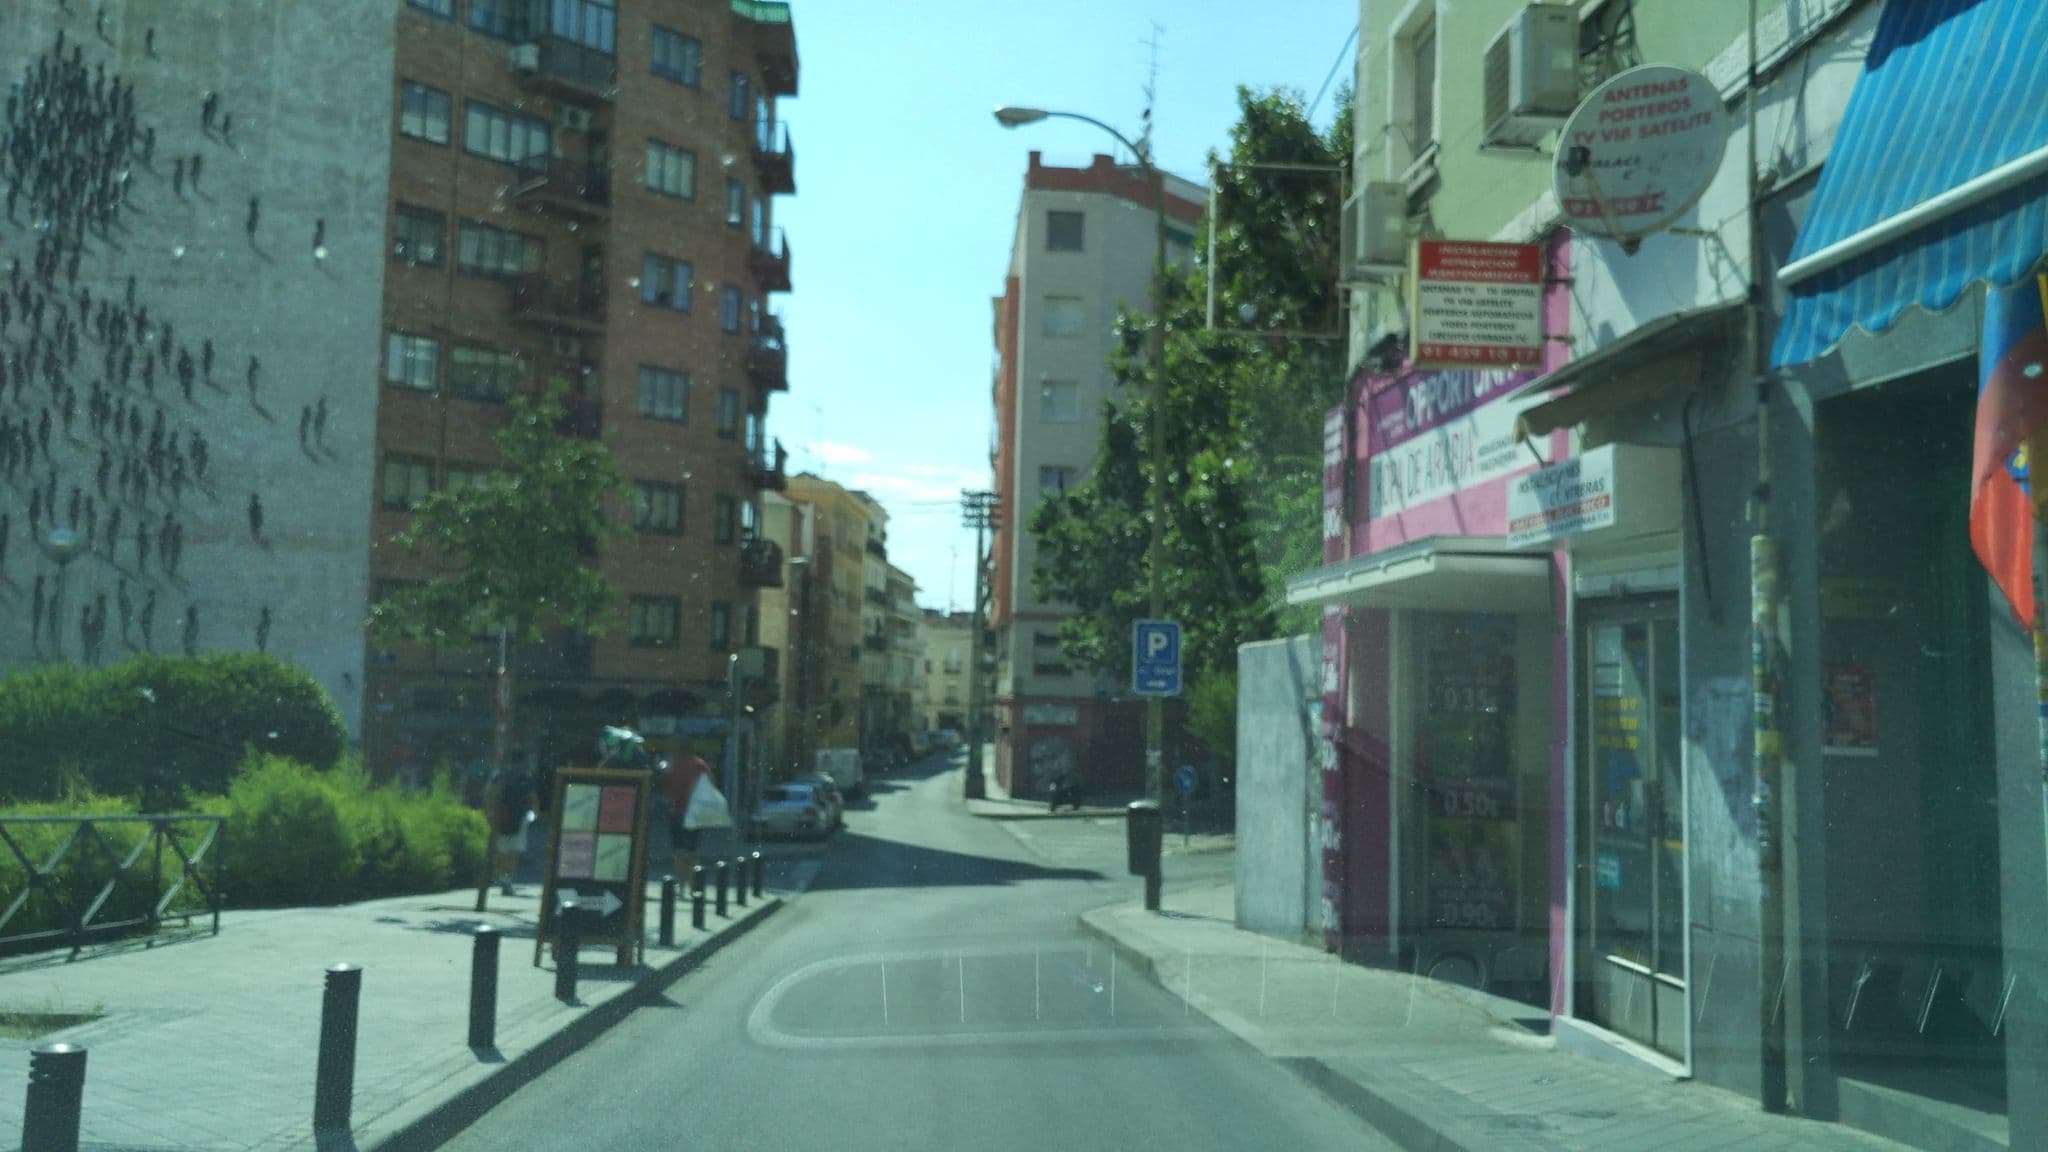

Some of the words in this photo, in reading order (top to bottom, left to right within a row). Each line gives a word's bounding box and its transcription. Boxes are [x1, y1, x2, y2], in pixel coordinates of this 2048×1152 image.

[1604, 78, 1688, 102] ANTENAS
[1598, 96, 1691, 123] PORTEROS
[1573, 130, 1595, 144] TV
[1639, 112, 1712, 139] SATELITE
[1147, 632, 1168, 657] P
